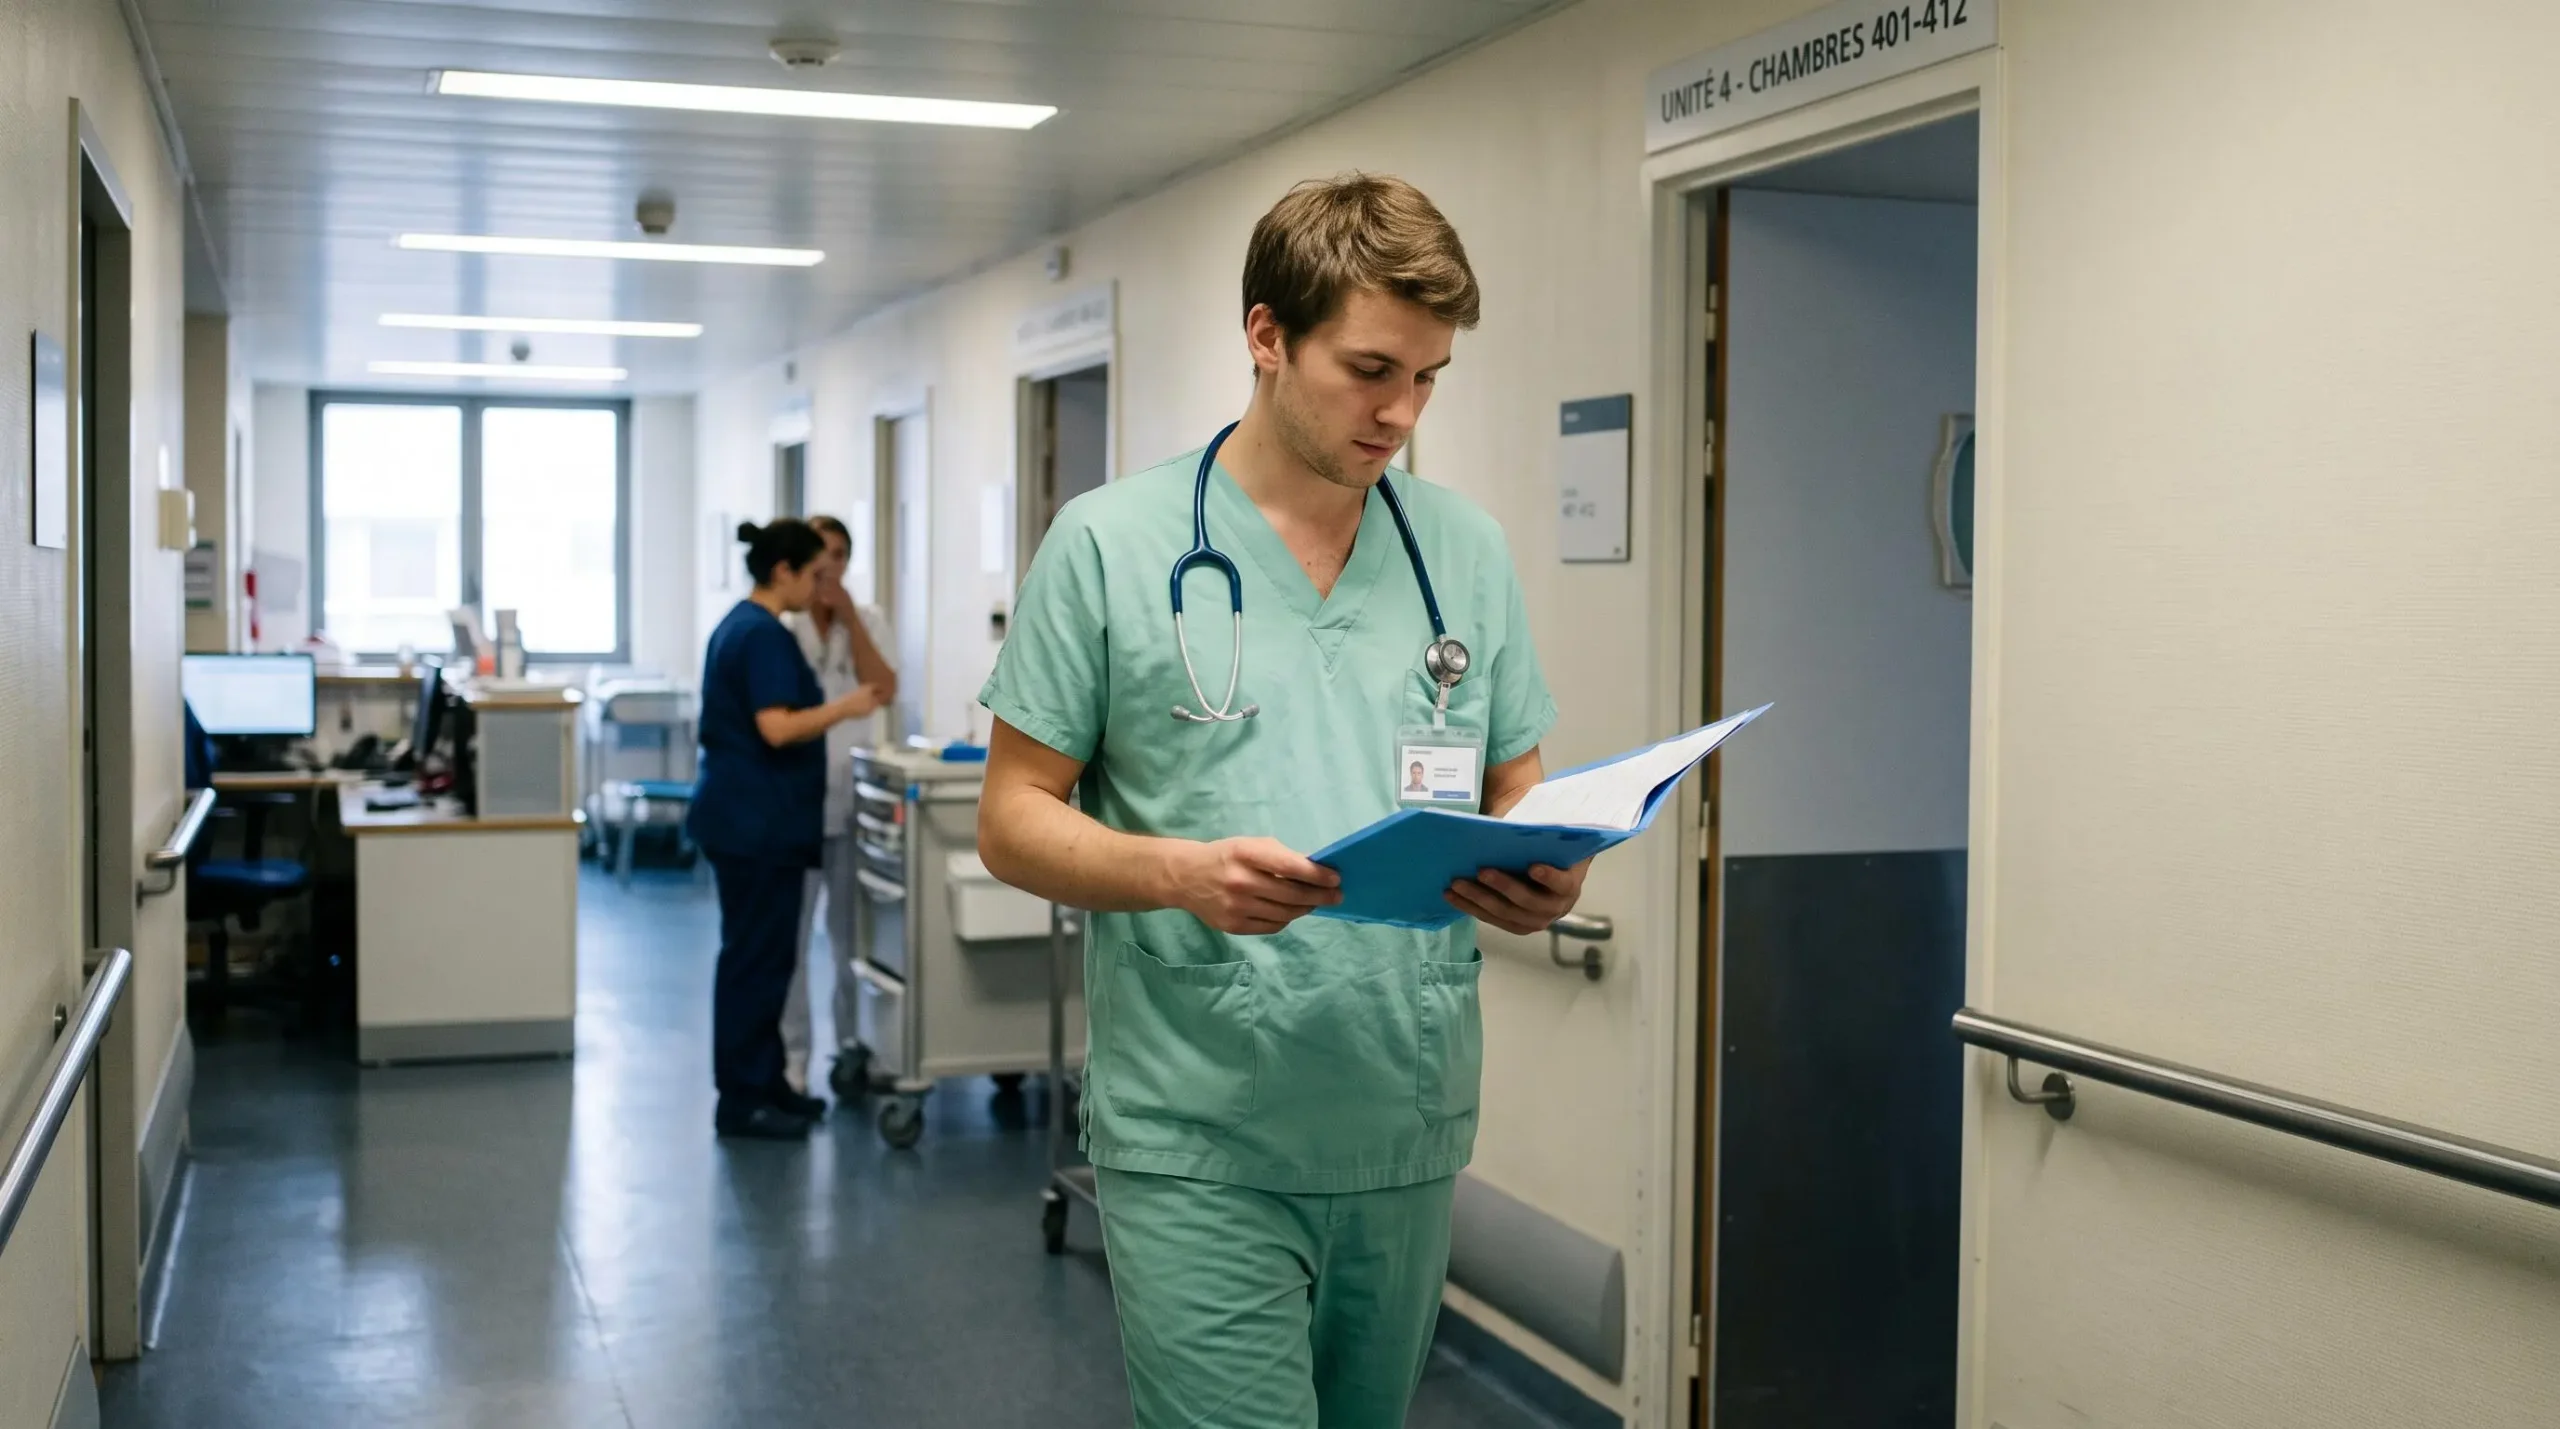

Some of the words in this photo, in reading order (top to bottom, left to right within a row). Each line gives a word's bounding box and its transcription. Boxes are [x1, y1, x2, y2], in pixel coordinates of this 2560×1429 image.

[1661, 68, 1715, 123] UNITÉ
[1719, 70, 1731, 102] 4
[1749, 23, 1865, 94] CHAMBRES
[1872, 0, 1967, 50] 401-412
